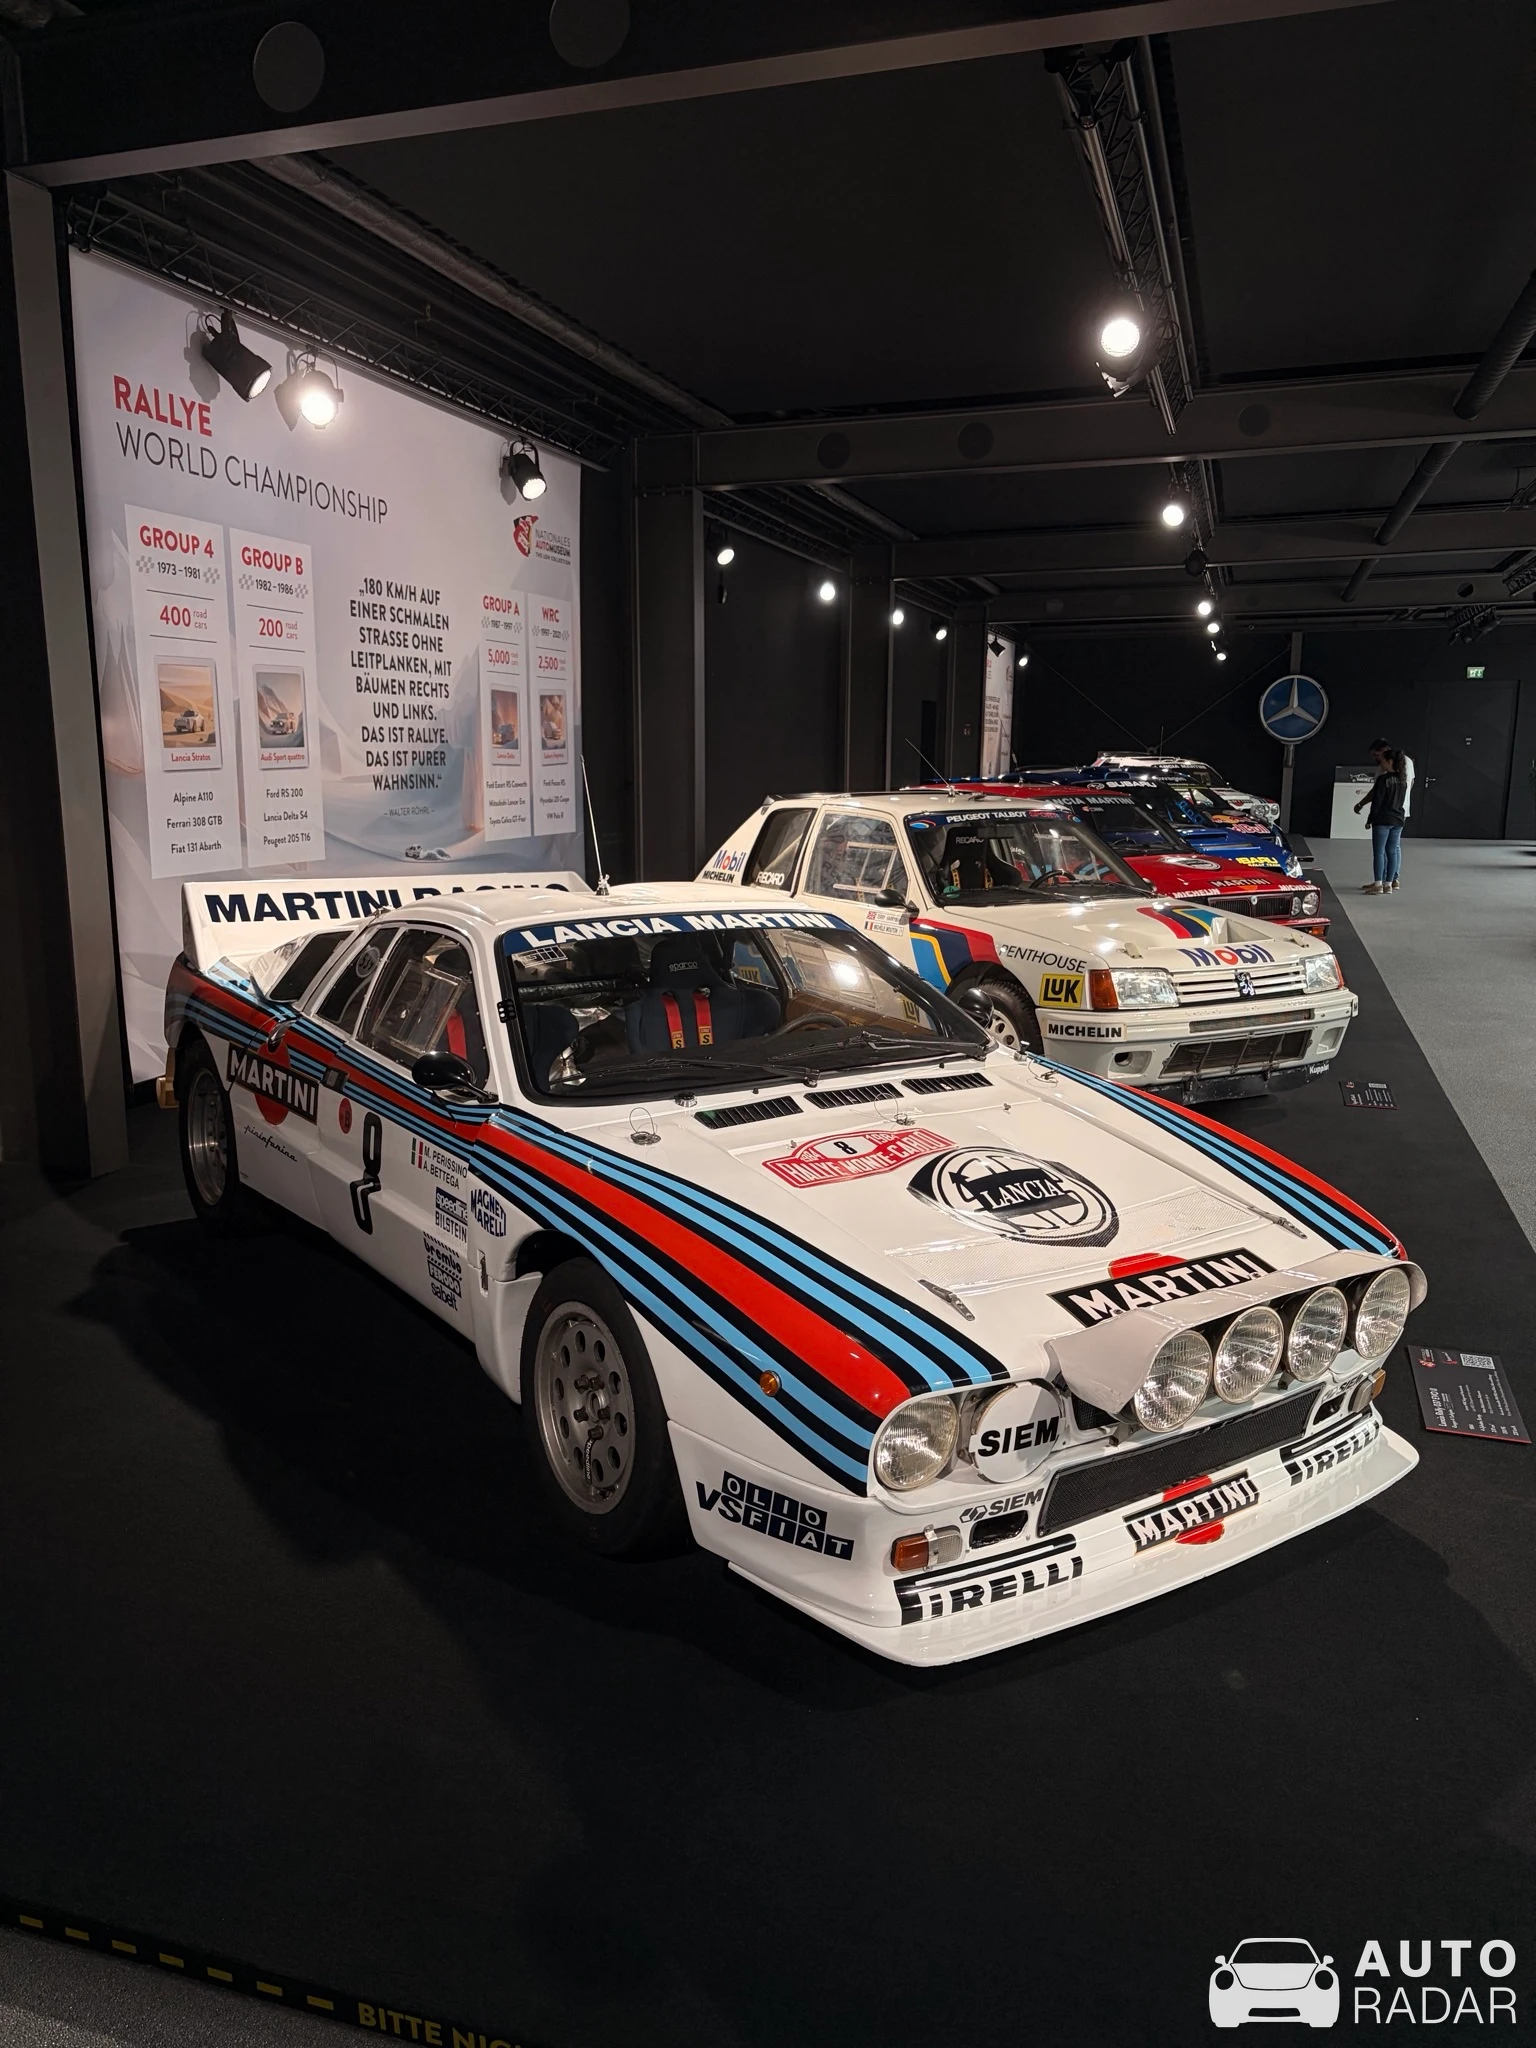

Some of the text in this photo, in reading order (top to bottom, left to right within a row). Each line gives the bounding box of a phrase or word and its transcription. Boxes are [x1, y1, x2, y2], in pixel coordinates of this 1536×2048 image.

[114, 374, 212, 437] RALLYE
[116, 422, 388, 525] WORLD CHAMPIONSHIP
[139, 525, 214, 558] GROUP 4
[535, 541, 571, 557] AUTOMUSEUM
[241, 547, 304, 575] GROUP B
[386, 581, 417, 602] KM/H
[420, 588, 440, 606] AUF
[160, 605, 191, 627] 400
[193, 610, 207, 619] road
[350, 600, 449, 631] EINER SCHMALEN
[483, 595, 520, 616] GROUP A
[542, 607, 559, 623] WRC
[194, 620, 207, 630] cars
[259, 617, 283, 638] 200
[285, 621, 298, 630] road
[286, 631, 298, 640] cars
[359, 626, 444, 653] STRASSE OHNE
[351, 650, 452, 678] LEITPLANKEN, MIT
[488, 649, 510, 667] 5,000
[538, 656, 559, 672] 2,500
[356, 672, 450, 699] BÄUMEN RECHTS
[373, 702, 437, 721] UND LINKS.
[361, 726, 449, 744] DAS IST RALLYE.
[171, 753, 211, 762] Lancia Stratos
[260, 753, 305, 763] Audi Sport quattro
[366, 751, 446, 767] DAS IST PURER
[173, 791, 213, 806] Alpine A110
[266, 788, 303, 798] Ford RS 200
[1045, 797, 1135, 806] ANCIA MARTINI
[166, 815, 223, 829] Ferrari 308 GTB
[263, 810, 308, 822] Lancia Delta S4
[389, 806, 430, 817] WALTER RÖHRL
[946, 812, 991, 823] PEUGEOT
[992, 811, 1027, 819] TALBOT
[171, 840, 222, 854] Fiat 131 Abarth
[263, 832, 311, 848] Peugeot 205 T16
[713, 850, 747, 872] Mobil
[702, 870, 735, 883] MICHELIN
[756, 871, 785, 886] RECARO
[1211, 878, 1271, 888] MARTINI
[1173, 888, 1221, 899] MICHELIN
[1278, 884, 1319, 892] MICHELIN
[204, 889, 403, 923] MARTINI
[519, 913, 837, 948] LANCIA MARTINI
[669, 961, 698, 972] sparco
[999, 944, 1088, 973] PENTHOUSE
[1177, 945, 1275, 967] Mobil
[1043, 978, 1081, 1003] LUK
[702, 1034, 710, 1044] S
[1048, 1023, 1122, 1038] MICHELIN
[229, 1049, 317, 1121] MARTINI
[243, 1125, 298, 1163] pininfarina
[834, 1141, 858, 1155] 8
[423, 1146, 468, 1179] M. PERISSINO
[779, 1131, 943, 1183] RALLYE MONTE-CARLO
[349, 1111, 383, 1236] 8
[423, 1162, 460, 1190] A. BETTEGA
[980, 1179, 1068, 1210] LANCIA
[435, 1210, 467, 1243] BILSTEIN
[424, 1238, 462, 1274] brembo
[429, 1264, 461, 1293] FERODO
[1068, 1254, 1269, 1323] MARTINI
[431, 1282, 458, 1311] sabelt
[977, 1416, 1059, 1458] SIEM
[1279, 1408, 1380, 1487] PIRELLI
[724, 1473, 825, 1530] OLIO
[988, 1488, 1044, 1517] SIEM
[1131, 1477, 1256, 1547] MARTINI
[894, 1534, 1083, 1626] PIRELLI
[357, 2001, 443, 2047] BITTE
